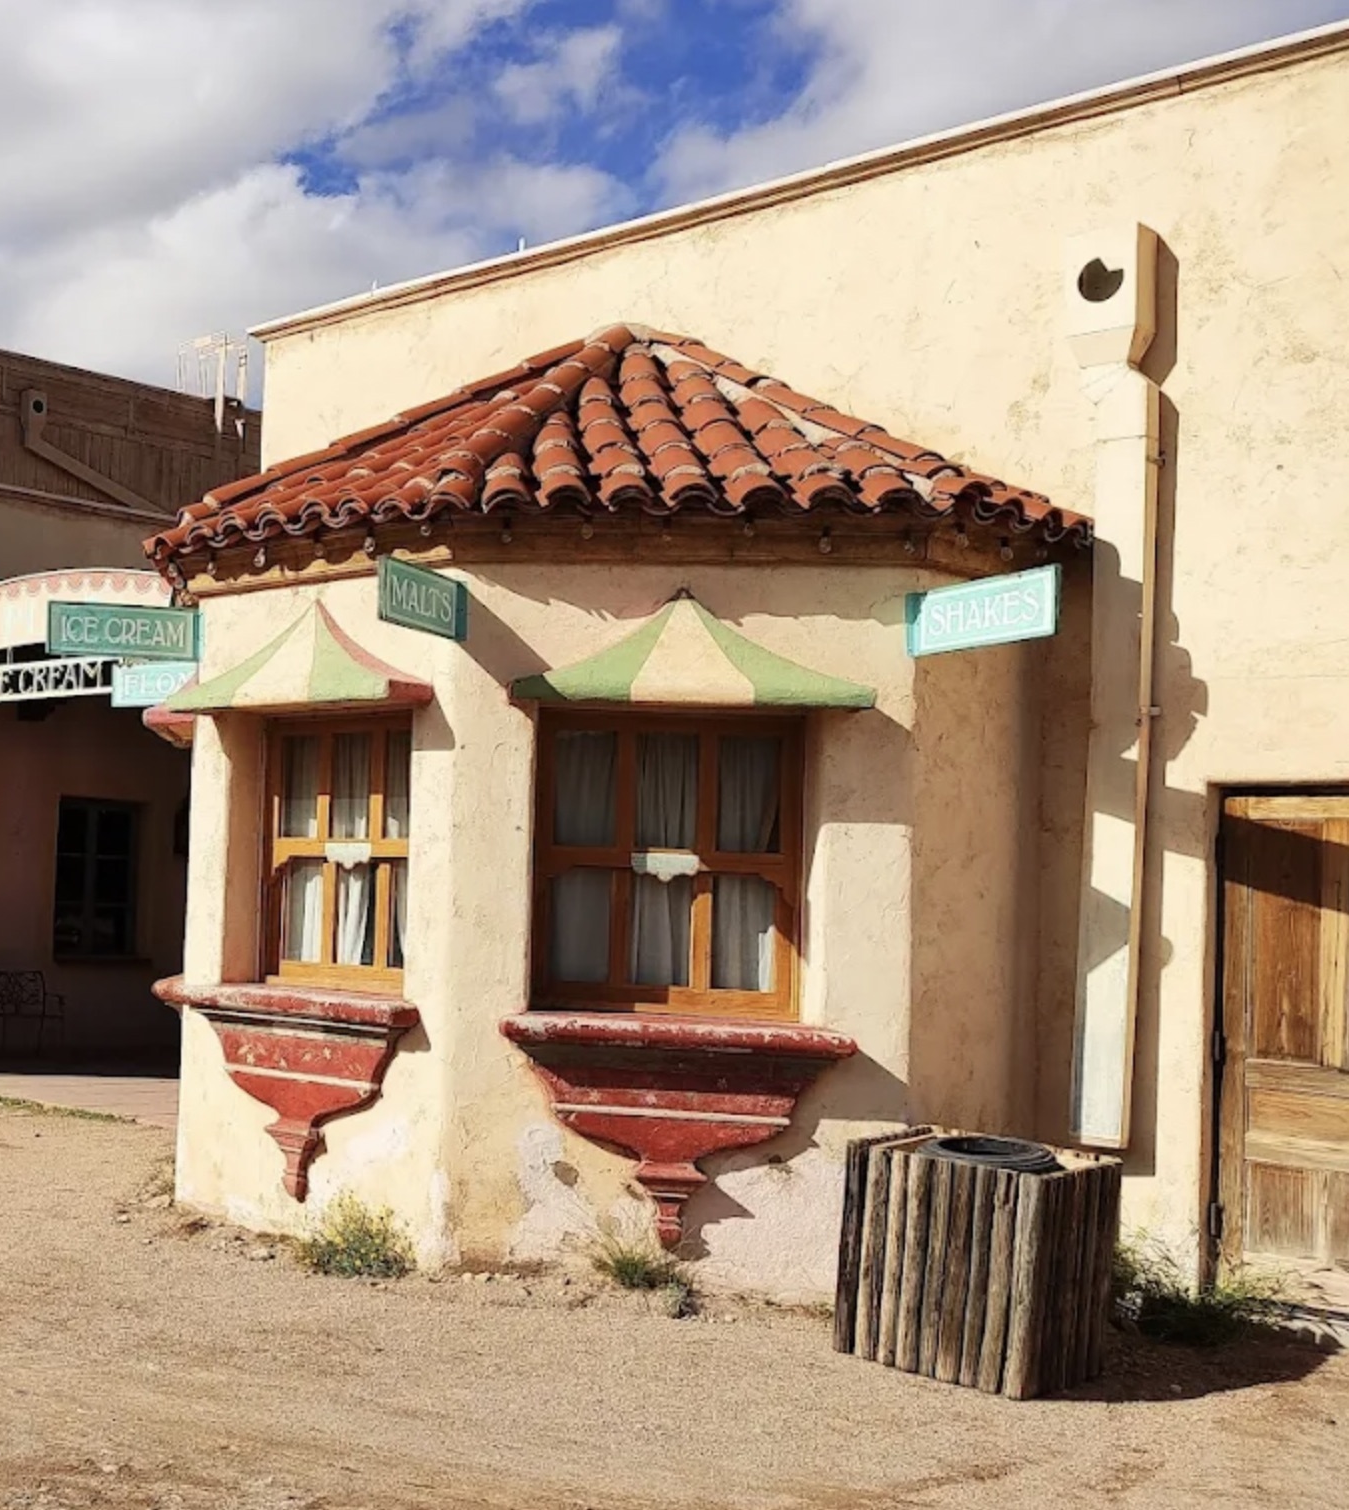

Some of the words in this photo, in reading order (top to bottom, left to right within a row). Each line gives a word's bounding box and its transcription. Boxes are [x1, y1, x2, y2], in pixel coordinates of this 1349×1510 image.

[391, 574, 452, 622] MALTS
[928, 588, 1040, 636] SHAKES
[60, 615, 100, 643] ICE
[105, 617, 185, 648] CREAM
[18, 660, 104, 696] CREAM
